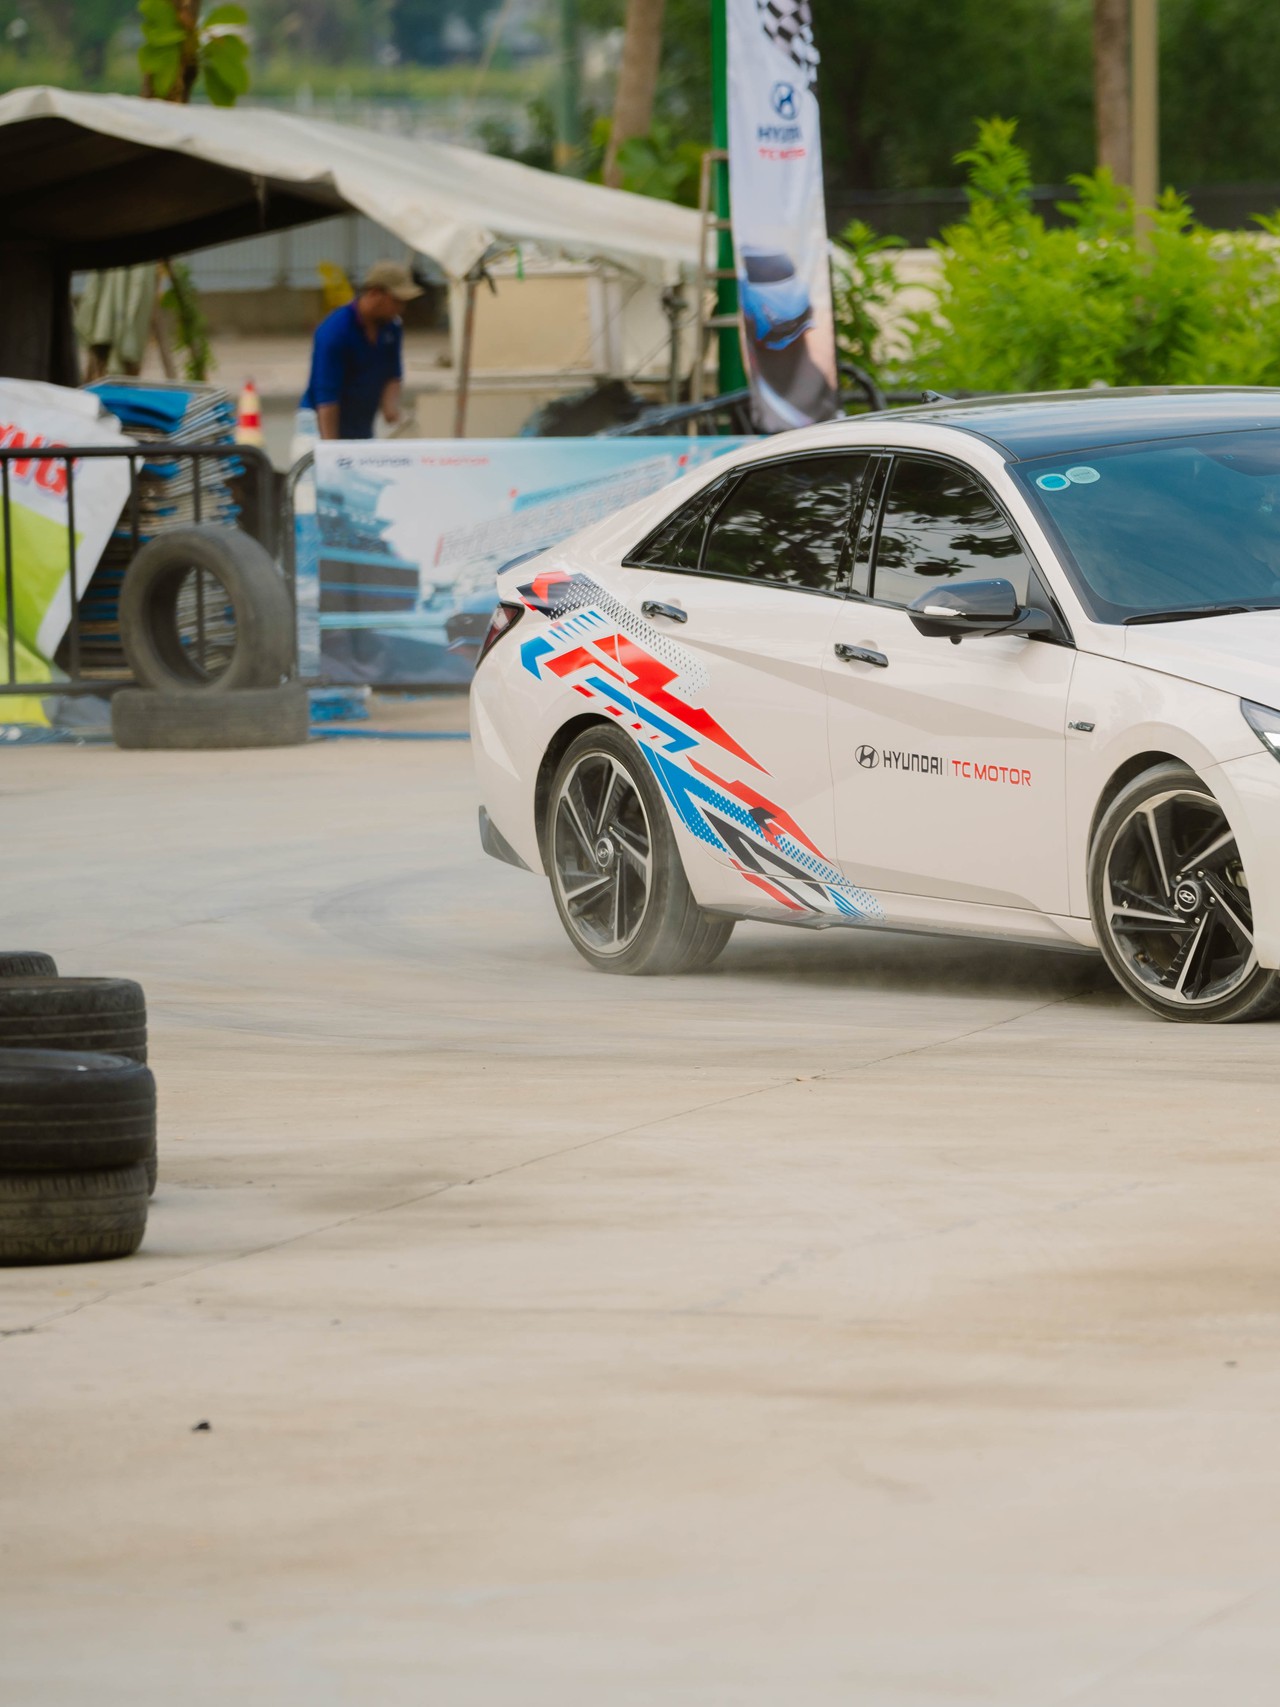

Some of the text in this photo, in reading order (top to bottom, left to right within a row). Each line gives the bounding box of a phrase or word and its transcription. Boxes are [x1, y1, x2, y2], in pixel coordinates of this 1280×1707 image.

[882, 750, 1032, 786] HYUNDAI TC MOTOR
